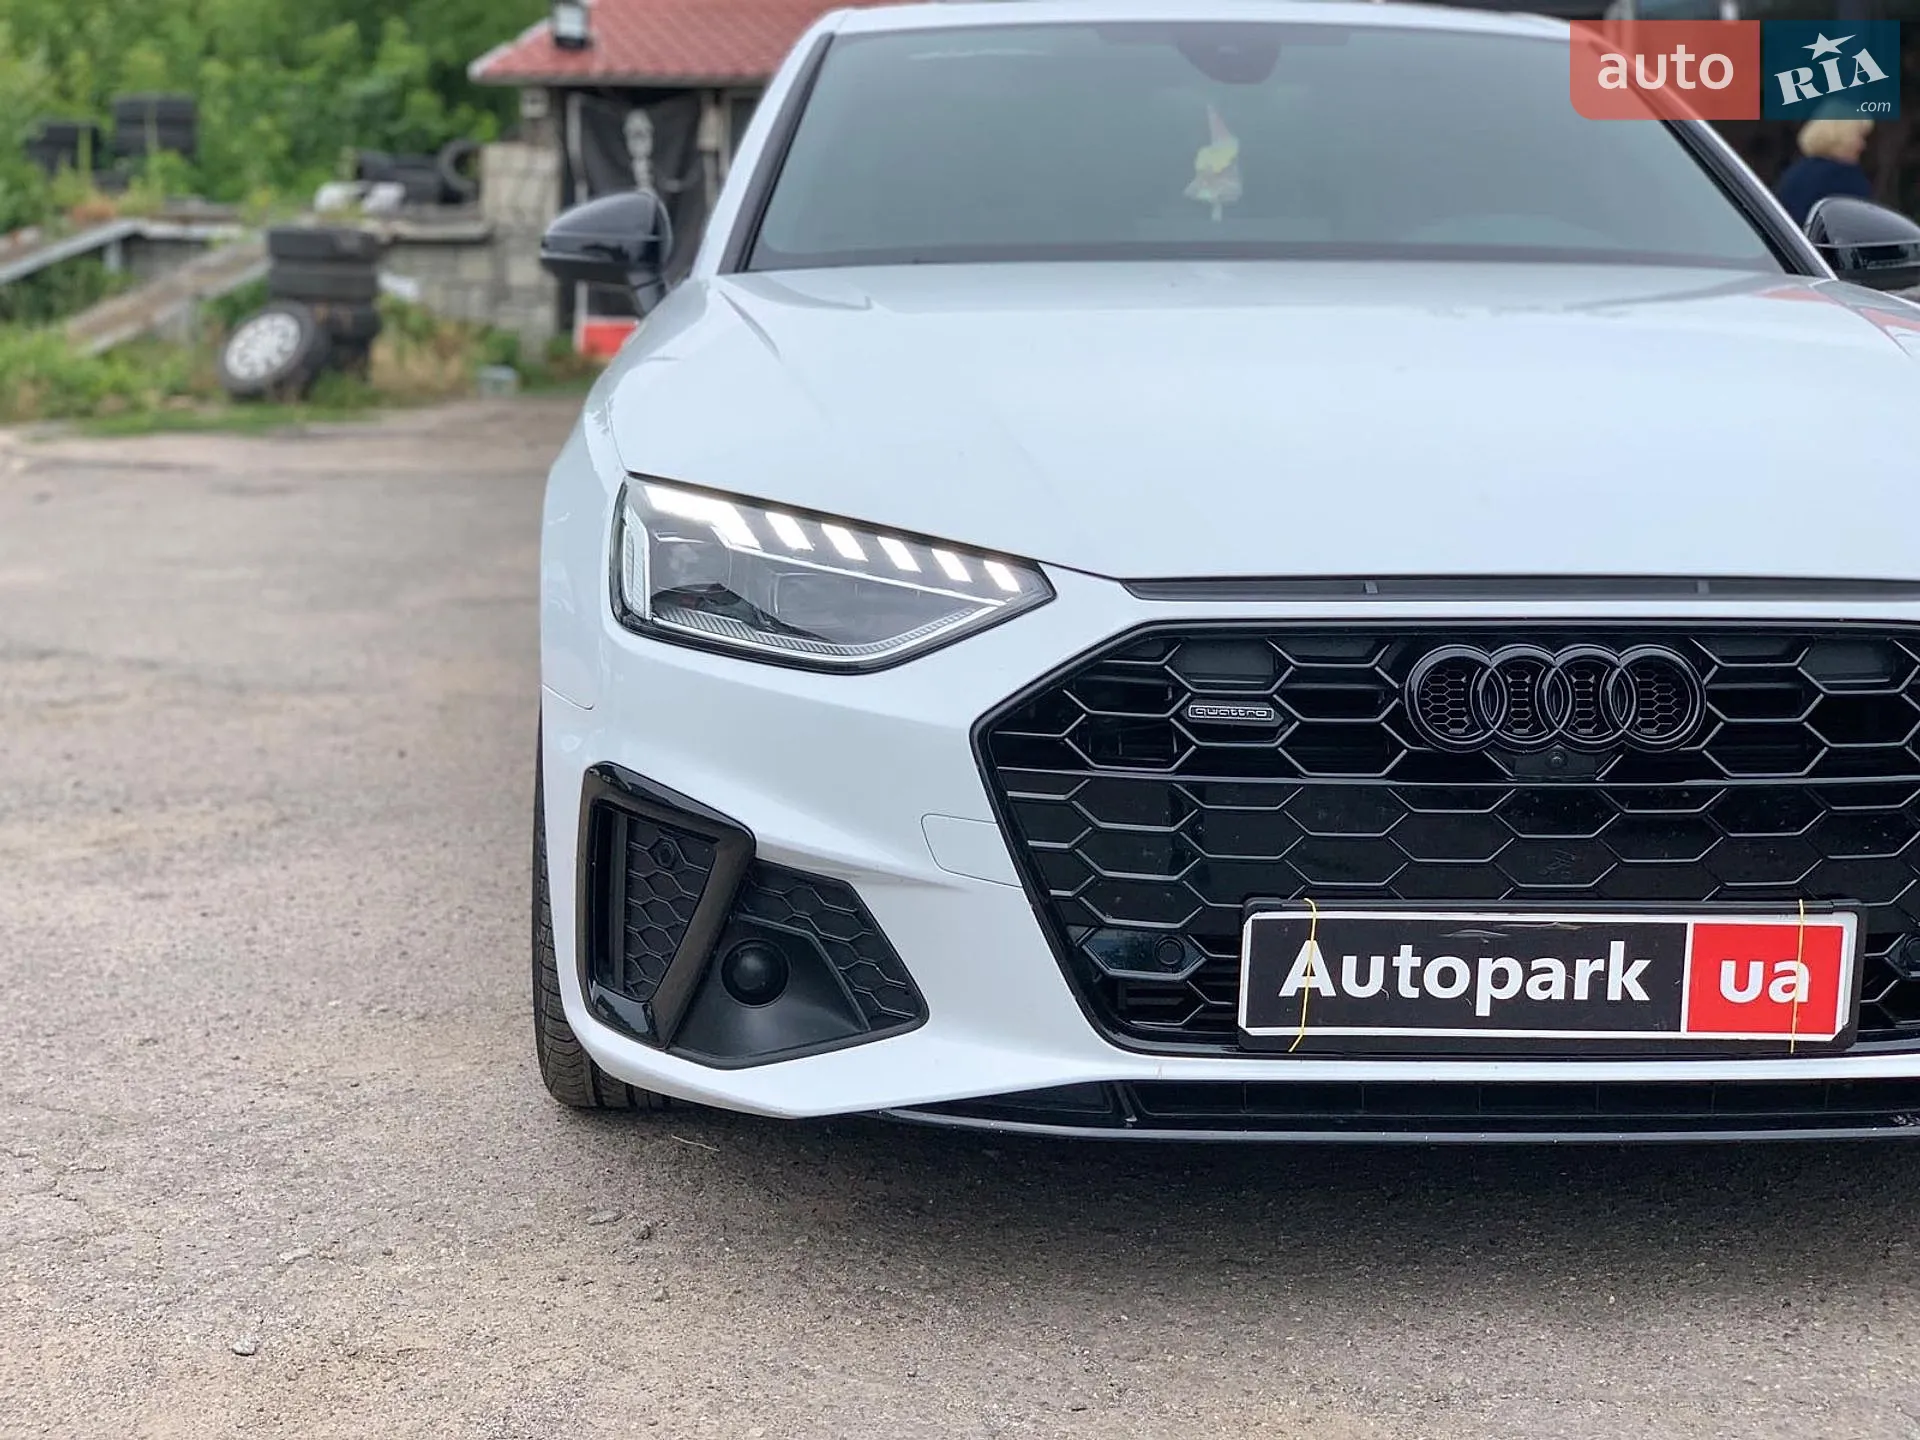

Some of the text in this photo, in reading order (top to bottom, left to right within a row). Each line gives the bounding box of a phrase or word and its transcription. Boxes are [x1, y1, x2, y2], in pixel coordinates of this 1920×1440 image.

[1195, 707, 1268, 717] quattro
[1278, 940, 1811, 1017] Autopark ua
